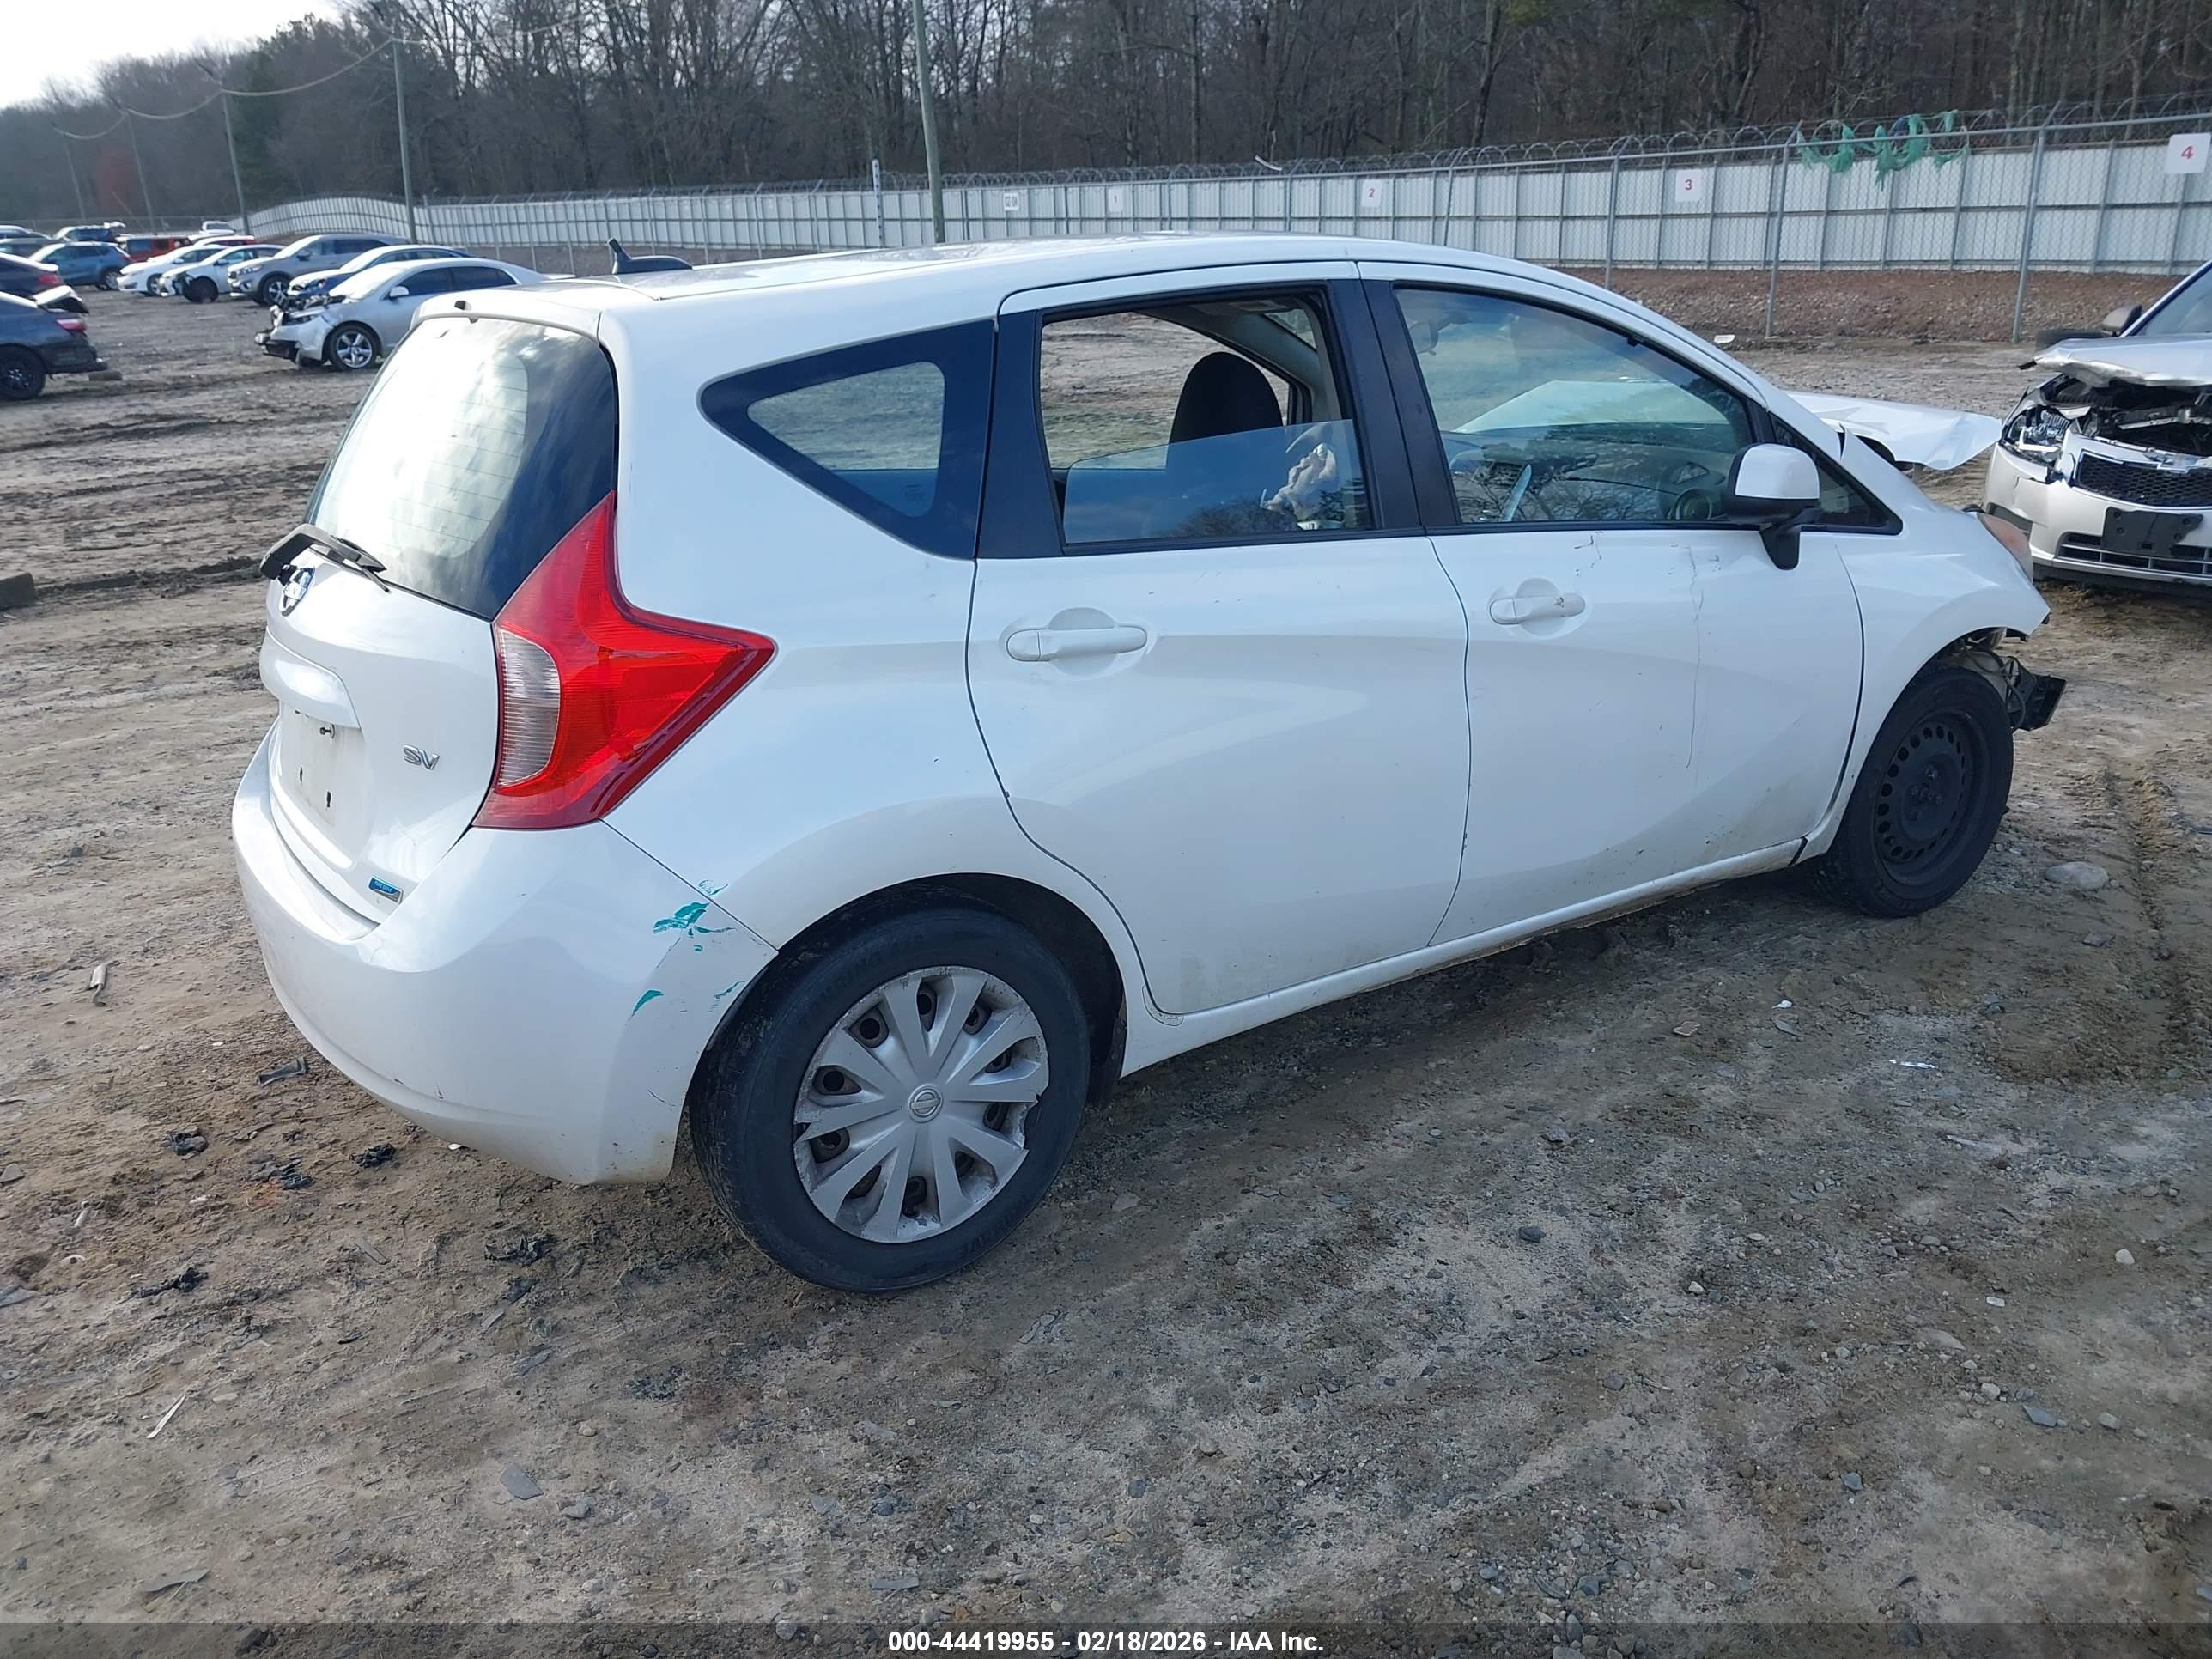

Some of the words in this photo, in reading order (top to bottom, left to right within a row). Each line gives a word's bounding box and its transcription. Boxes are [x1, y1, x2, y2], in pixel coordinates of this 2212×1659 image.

[2181, 146, 2193, 160] 4
[1685, 179, 1692, 190] 3
[1368, 188, 1375, 198] 2
[404, 744, 440, 770] SV
